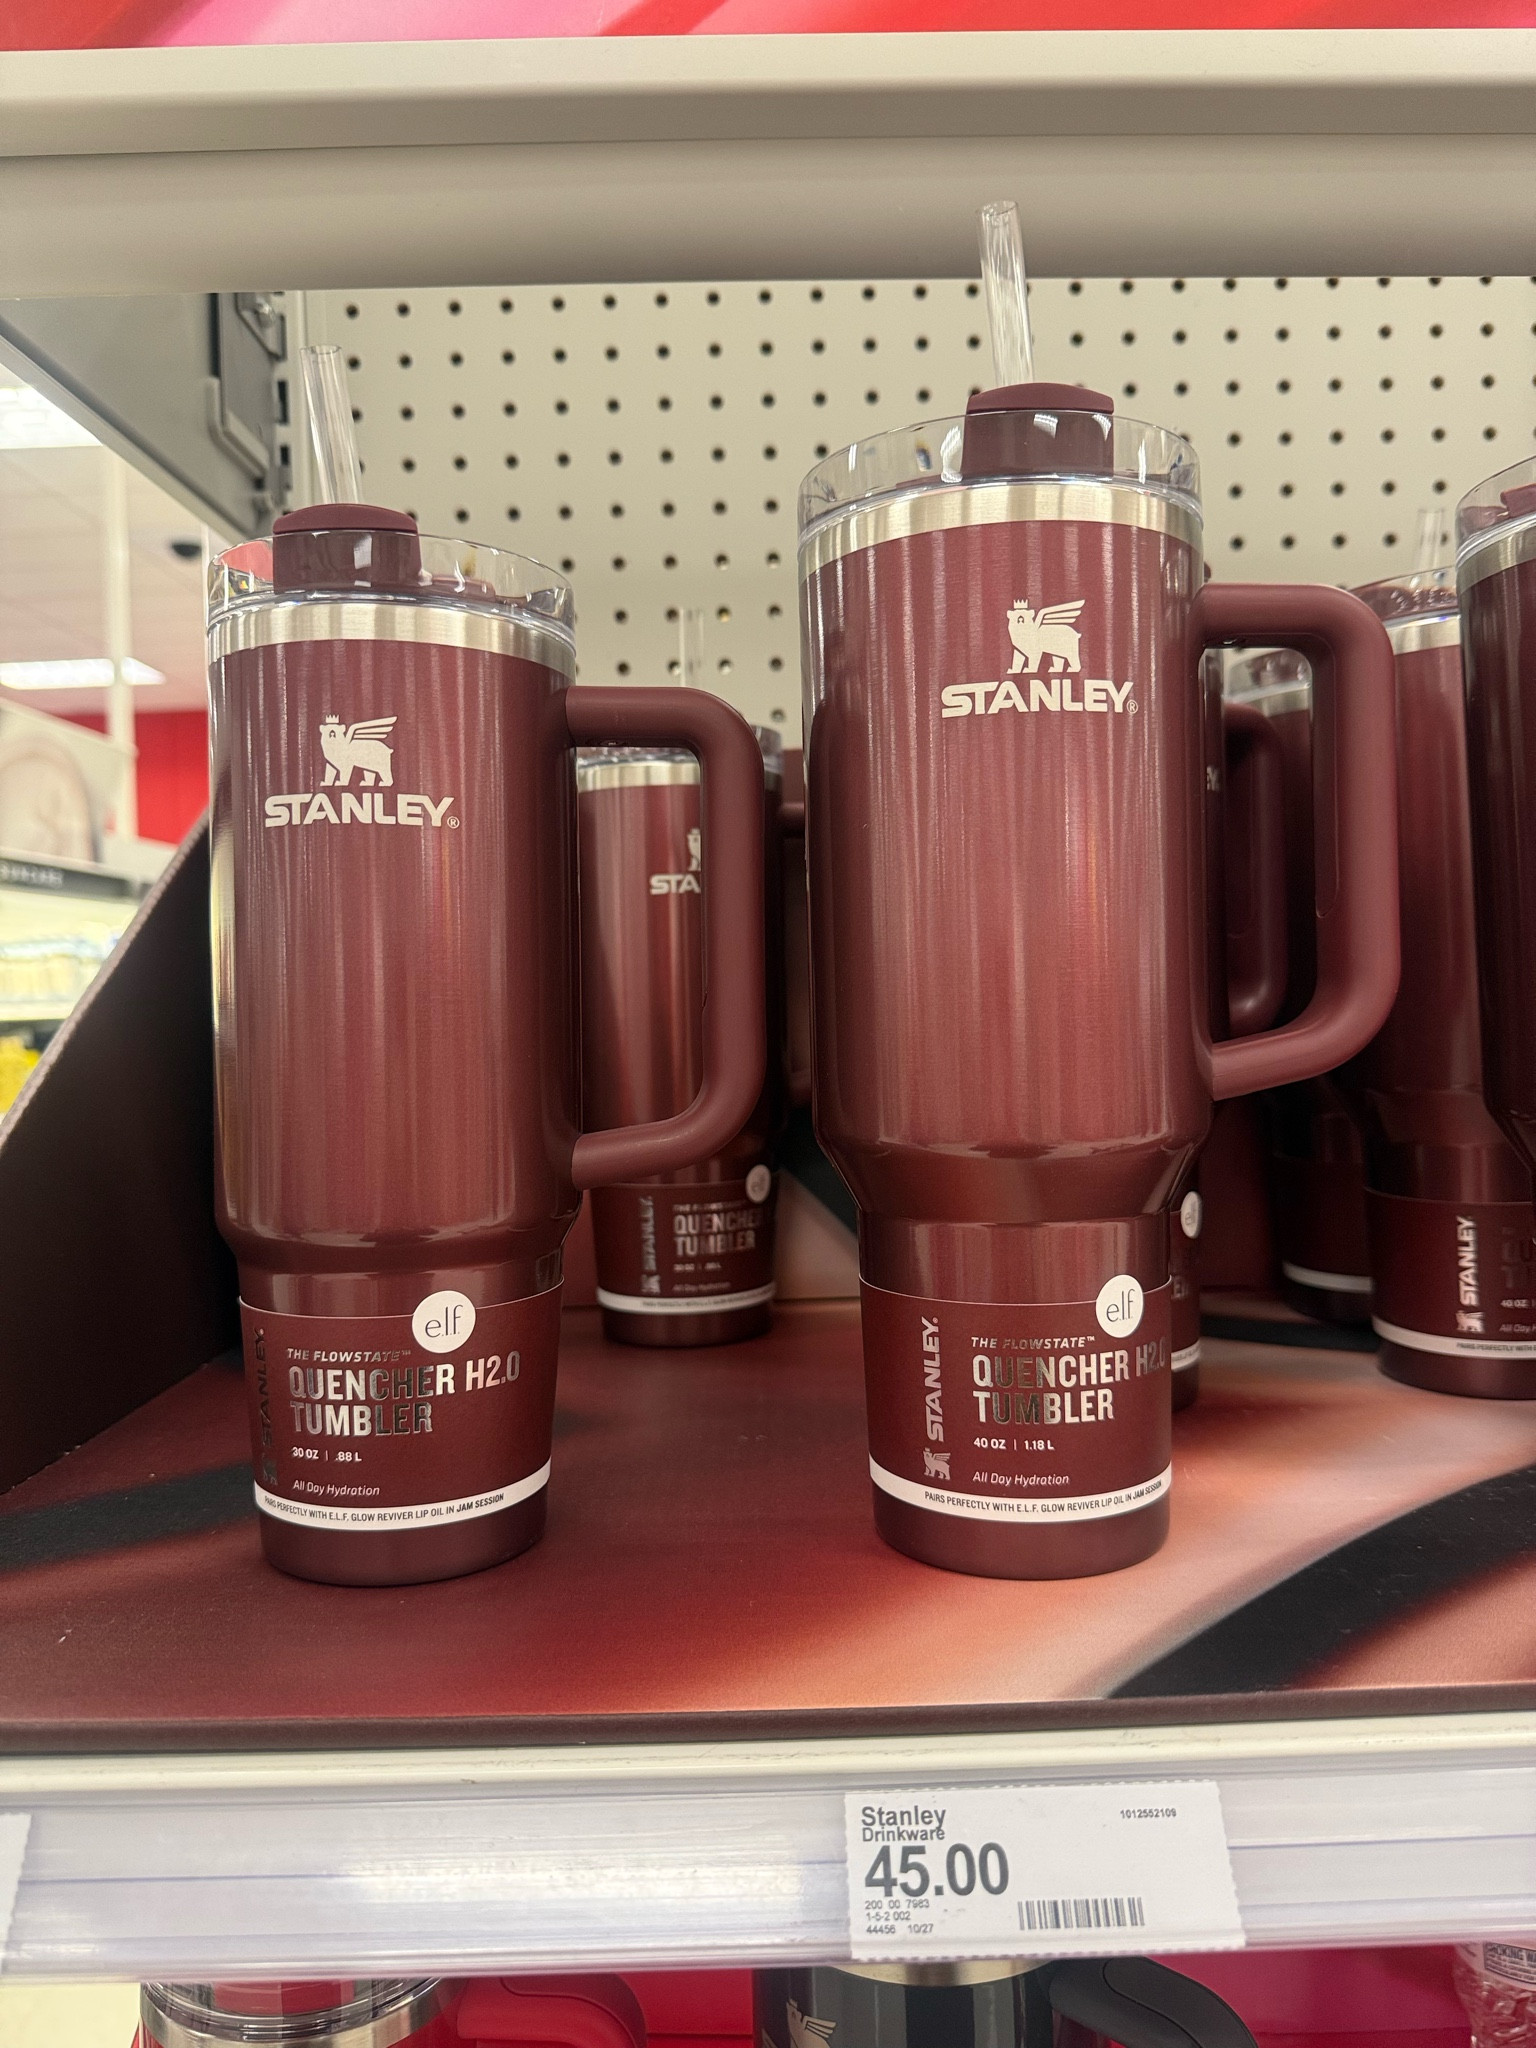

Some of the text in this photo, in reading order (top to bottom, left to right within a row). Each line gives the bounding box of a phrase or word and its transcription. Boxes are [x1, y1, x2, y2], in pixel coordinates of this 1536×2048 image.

[287, 1347, 310, 1360] THE
[971, 1336, 998, 1349] THE
[288, 1350, 521, 1401] QUENCHER H2.0
[972, 1349, 1130, 1389] QUENCHER
[289, 1400, 433, 1437] TUMBLER
[972, 1388, 1116, 1425] TUMBLER
[292, 1446, 363, 1462] 30 OZ .88 L
[973, 1437, 1055, 1451] 40 OZ 1.18 L
[293, 1478, 381, 1498] All Day Hydration
[972, 1471, 1070, 1488] All Day Hydration
[276, 1501, 308, 1517] PERFECTLY
[308, 1509, 328, 1520] WITH
[351, 1512, 376, 1522] GLOW
[377, 1511, 414, 1522] REVIVER
[415, 1509, 429, 1519] LIP
[430, 1508, 444, 1517] OIL
[445, 1505, 455, 1515] IN
[456, 1501, 474, 1513] JAM
[474, 1492, 505, 1509] SESSION
[924, 1490, 946, 1504] PAIRS
[946, 1496, 991, 1511] PERFECTLY
[992, 1503, 1015, 1512] WITH
[1041, 1503, 1066, 1513] GLOW
[1067, 1499, 1100, 1511] REVIVER
[1101, 1497, 1113, 1507] LIP
[1113, 1495, 1125, 1505] OIL
[1125, 1492, 1133, 1502] IN
[1133, 1487, 1145, 1500] JAM
[861, 1805, 947, 1831] Stanley
[861, 1826, 946, 1843] Drinkware
[864, 1841, 1010, 1898] 45.00
